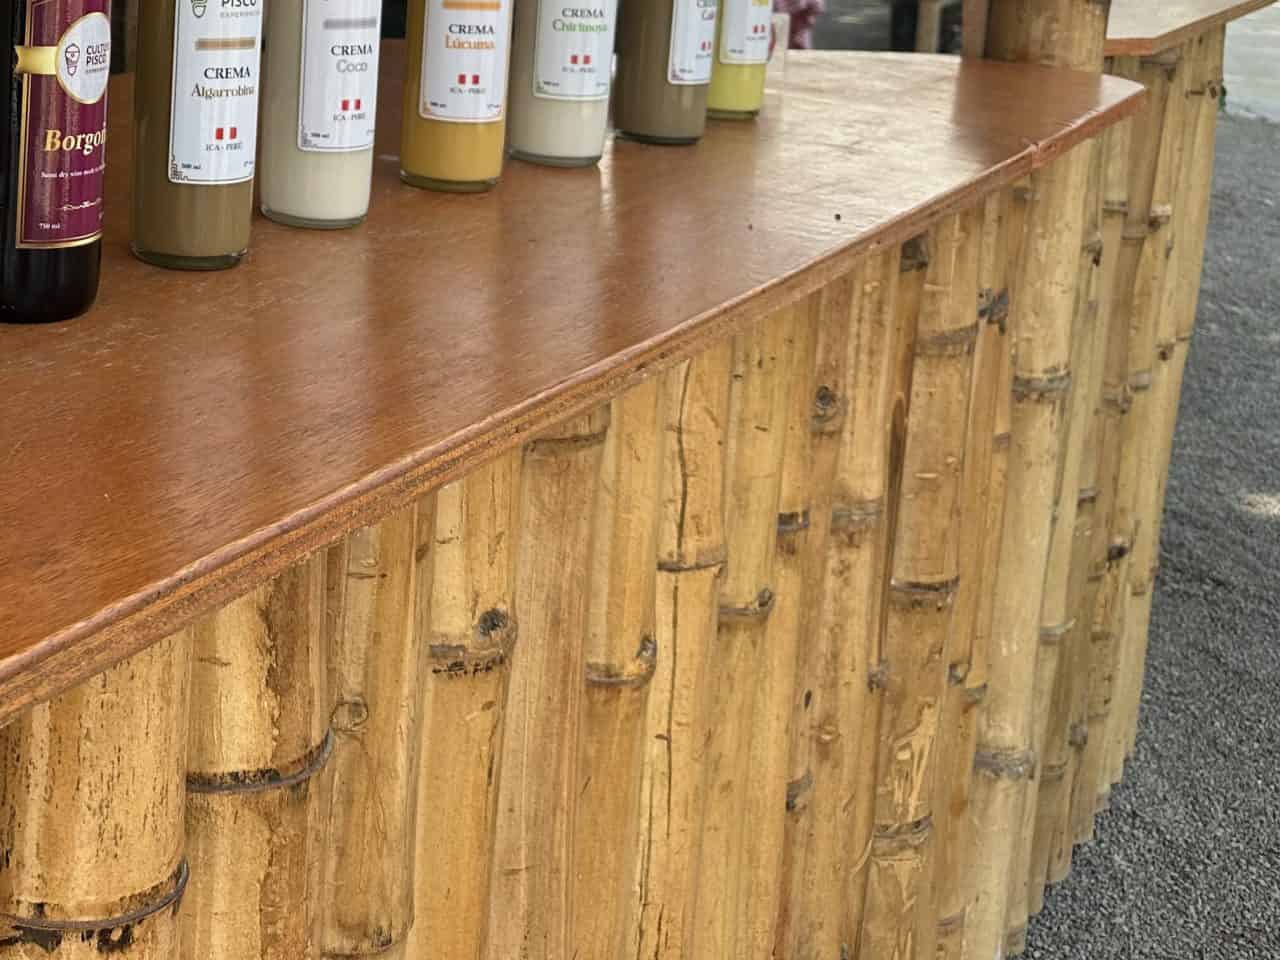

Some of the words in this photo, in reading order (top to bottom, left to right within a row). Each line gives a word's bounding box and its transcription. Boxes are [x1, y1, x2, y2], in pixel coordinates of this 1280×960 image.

[561, 8, 605, 18] CREMA
[448, 23, 496, 35] CREMA
[330, 43, 373, 56] CREMA
[203, 66, 250, 79] CREMA
[335, 59, 368, 73] Coco
